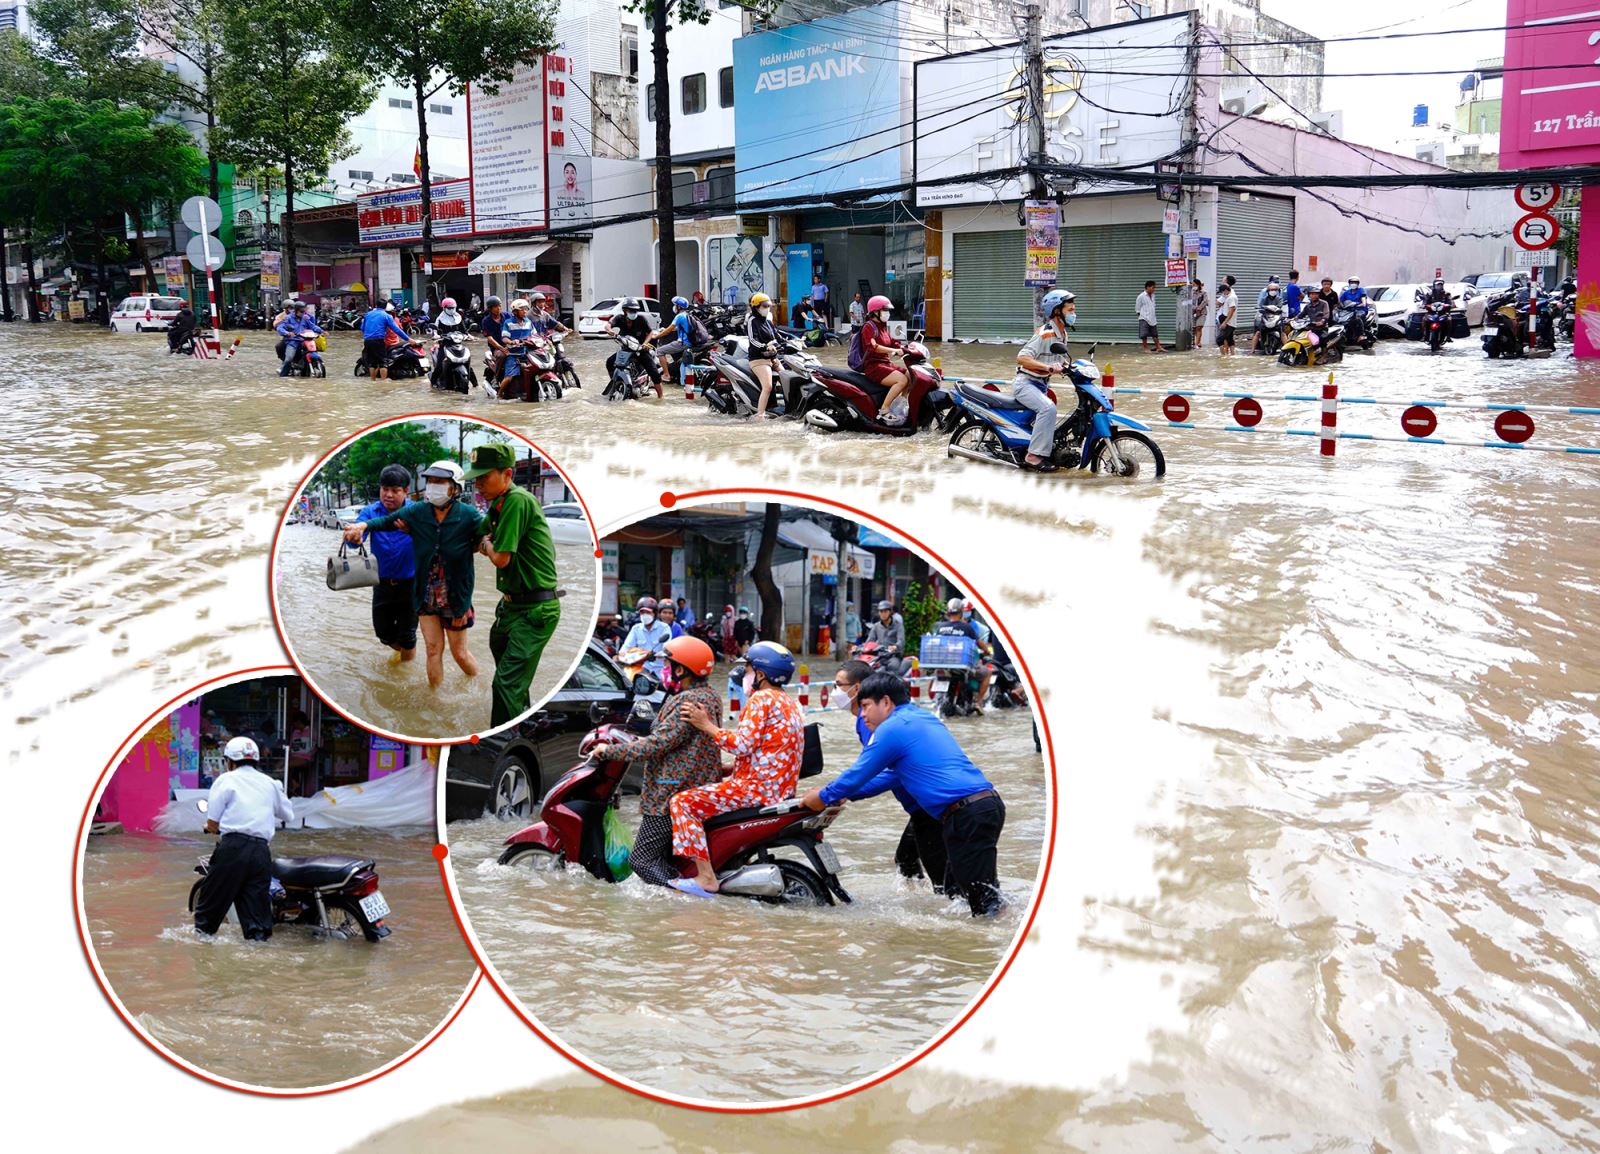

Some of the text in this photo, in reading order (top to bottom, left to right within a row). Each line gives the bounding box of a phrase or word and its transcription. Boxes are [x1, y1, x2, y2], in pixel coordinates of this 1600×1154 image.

[760, 54, 782, 67] NGÂN
[783, 48, 806, 62] HÀNG
[806, 45, 829, 57] TMCP
[832, 41, 844, 51] AN
[754, 53, 867, 94] ABBANK
[1533, 118, 1562, 133] 127
[740, 817, 780, 830] VISION
